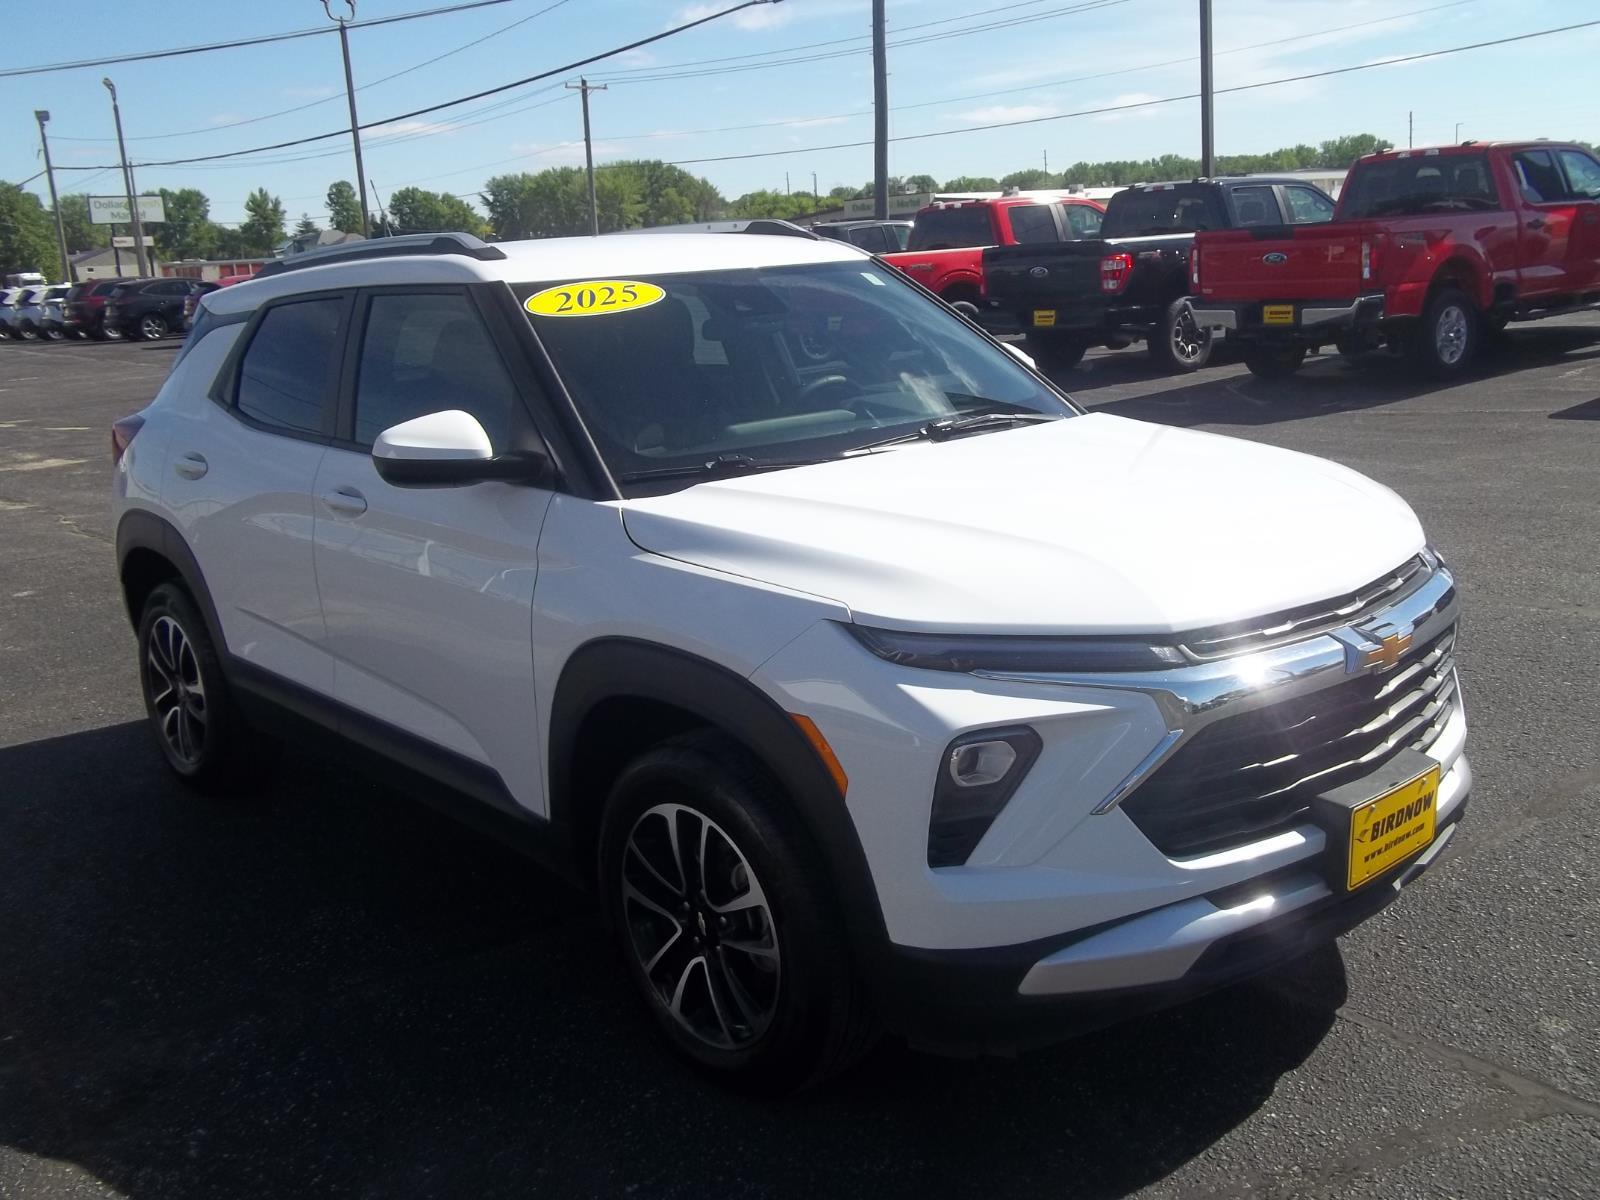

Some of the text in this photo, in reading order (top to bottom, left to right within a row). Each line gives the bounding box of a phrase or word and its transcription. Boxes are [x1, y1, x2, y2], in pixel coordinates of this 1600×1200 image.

[93, 200, 123, 210] Dollar
[554, 284, 638, 313] 2025
[1370, 790, 1435, 842] BIRDNOW
[1363, 822, 1425, 863] www.birdnow.com
